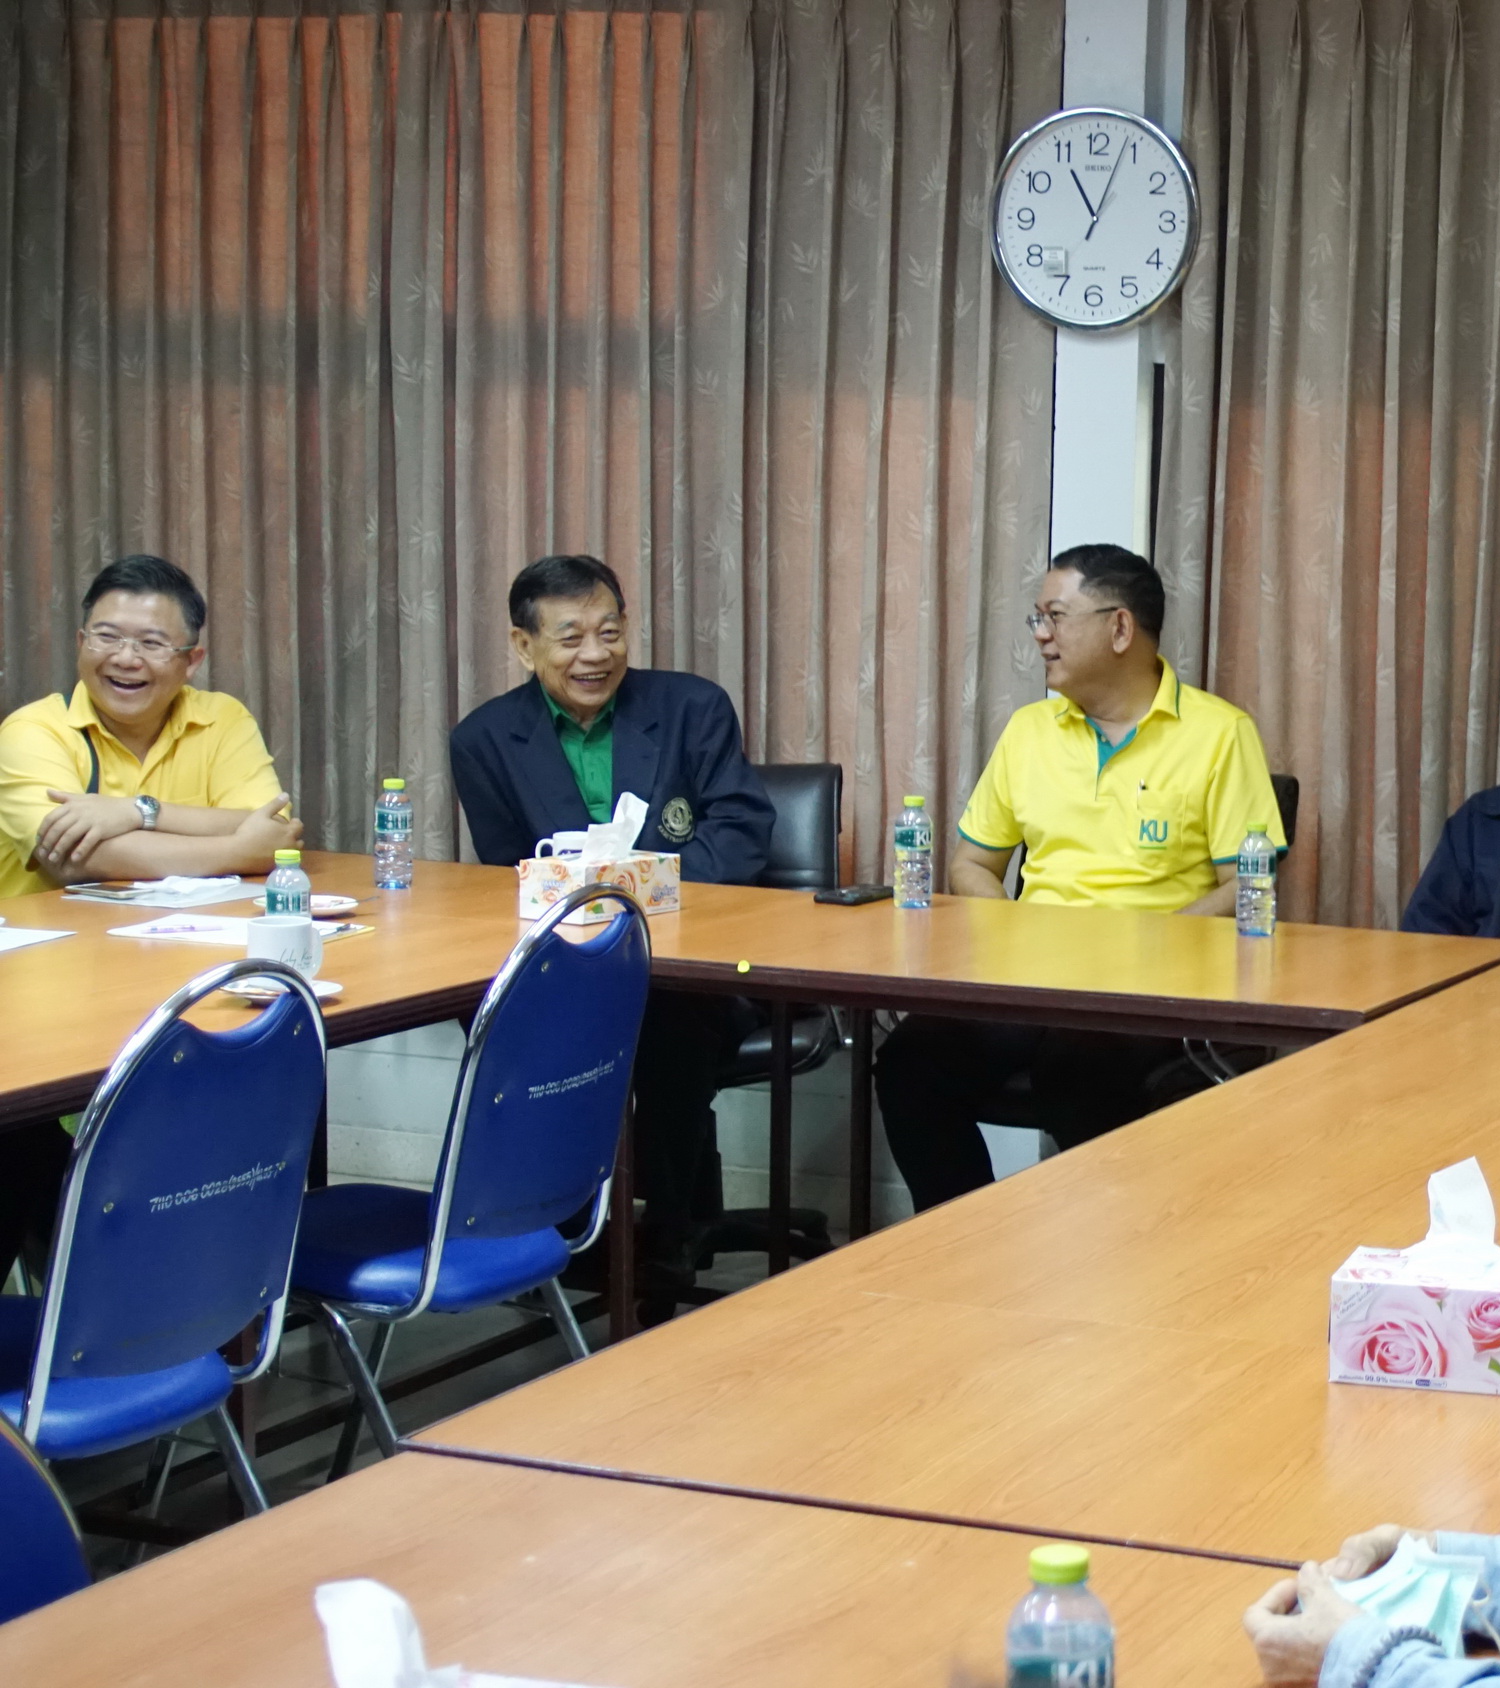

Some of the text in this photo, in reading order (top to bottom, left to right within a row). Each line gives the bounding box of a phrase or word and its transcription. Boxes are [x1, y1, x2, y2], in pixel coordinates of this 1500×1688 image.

[1054, 140, 1071, 163] 11
[1086, 132, 1110, 156] 12
[1130, 141, 1137, 164] 1
[1026, 170, 1052, 194] 10
[1149, 171, 1167, 195] 2
[1017, 207, 1035, 231] 9
[1158, 210, 1176, 234] 3
[1026, 244, 1043, 267] 8
[1146, 247, 1163, 271] 4
[1053, 274, 1071, 297] 7
[1084, 285, 1103, 307] 6
[1120, 276, 1139, 298] 5
[1139, 819, 1168, 843] KU
